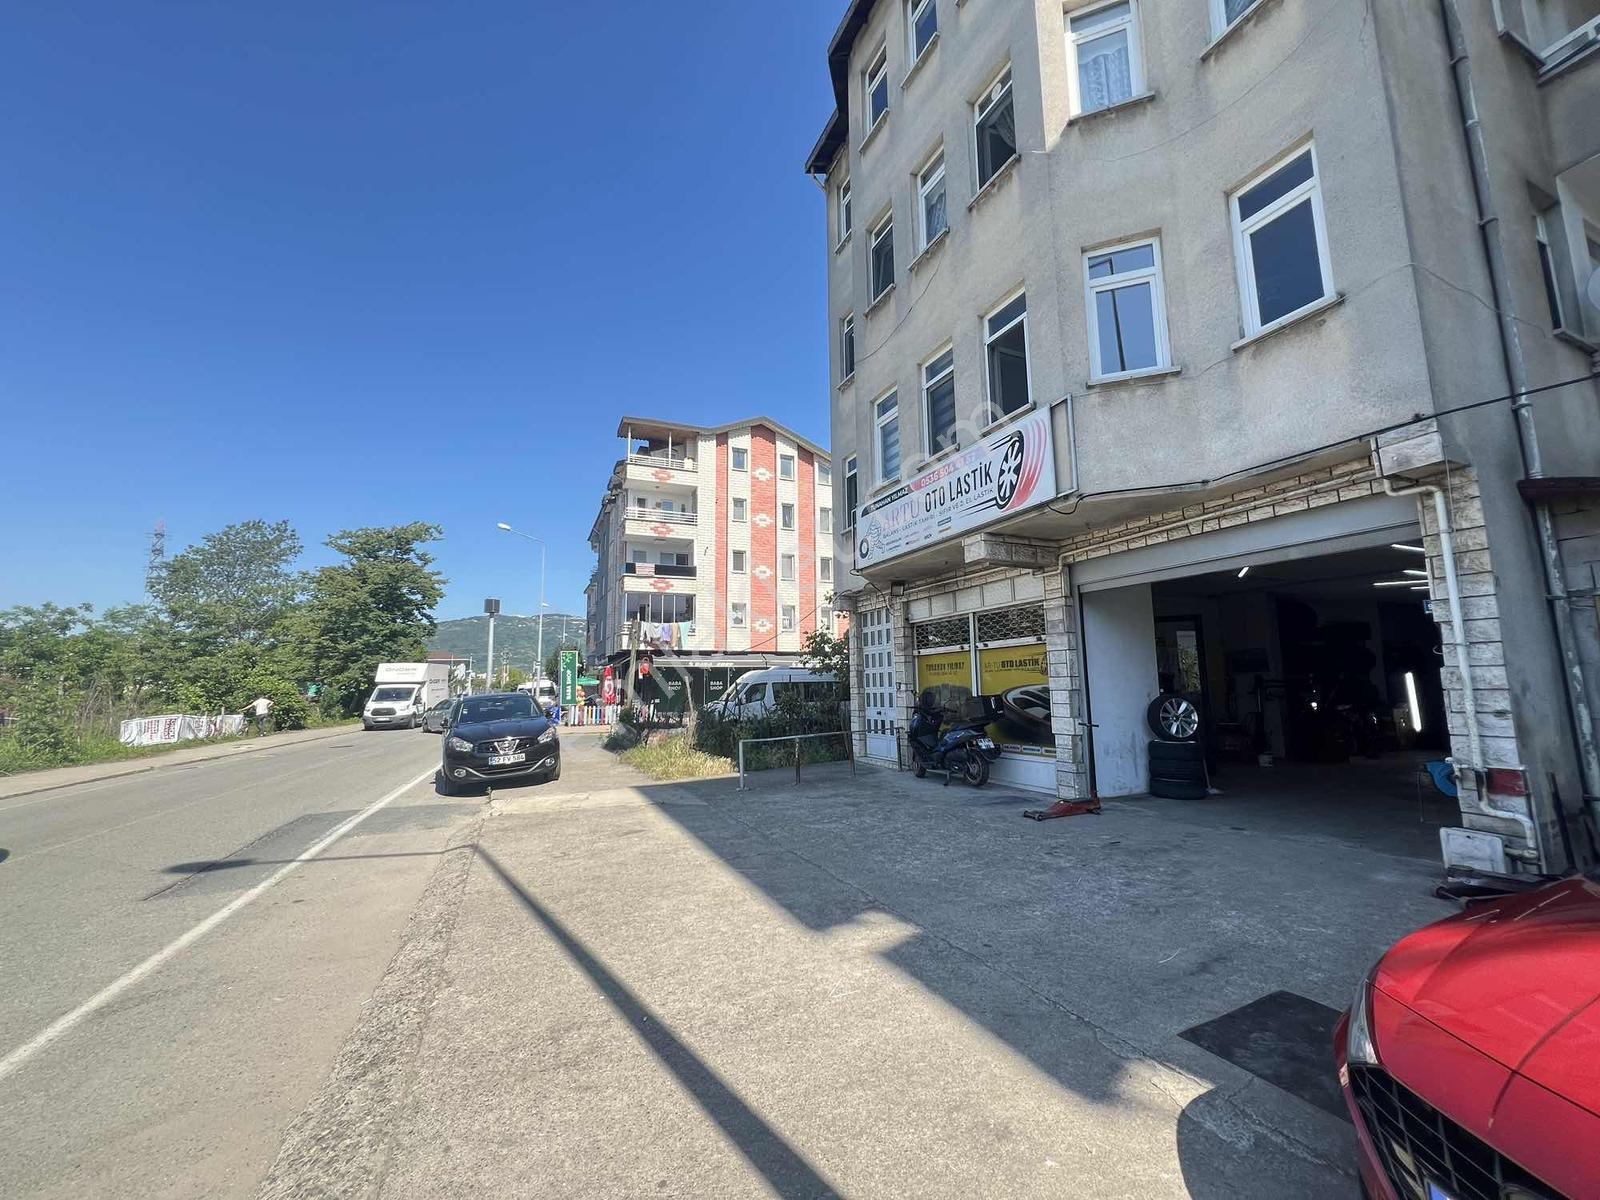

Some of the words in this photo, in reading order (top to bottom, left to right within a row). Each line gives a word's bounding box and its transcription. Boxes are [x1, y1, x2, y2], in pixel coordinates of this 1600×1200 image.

[924, 486, 946, 513] OTO
[949, 461, 993, 502] LASTİK
[1001, 660, 1014, 668] OTO
[1015, 656, 1039, 668] LASTİK
